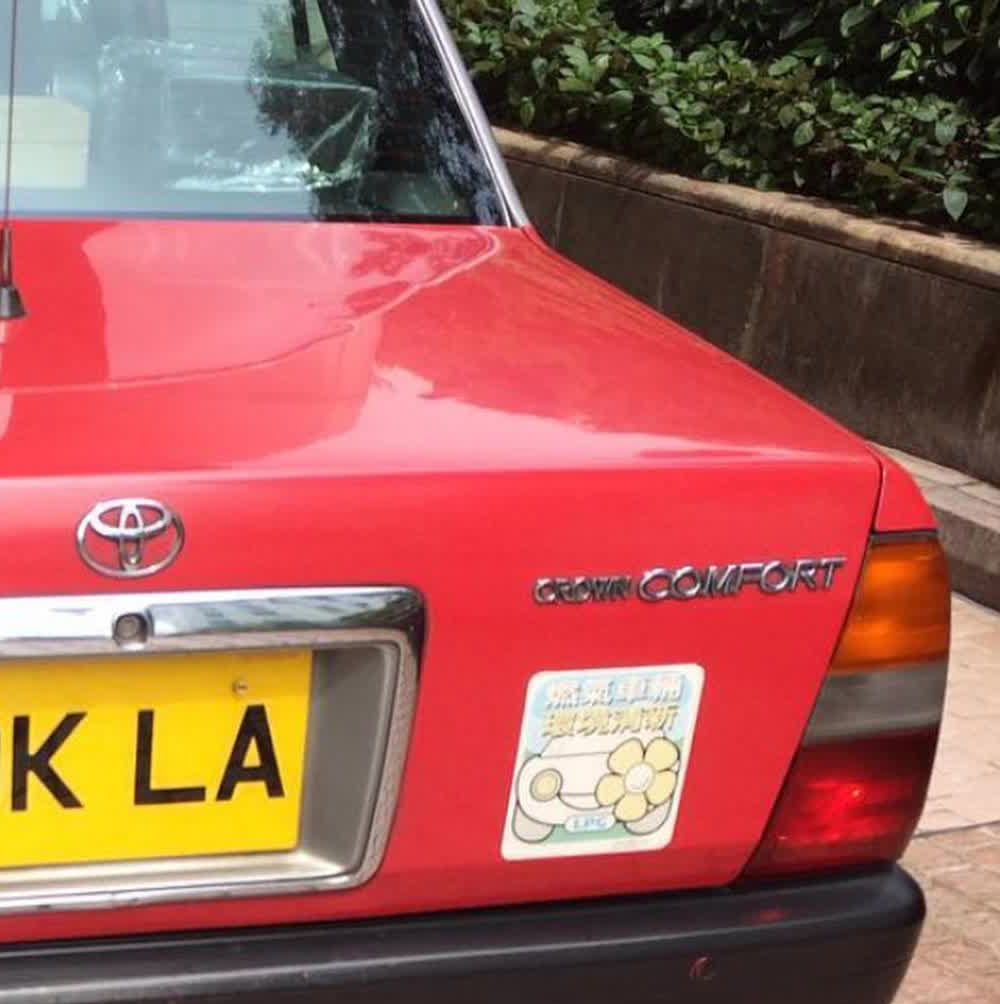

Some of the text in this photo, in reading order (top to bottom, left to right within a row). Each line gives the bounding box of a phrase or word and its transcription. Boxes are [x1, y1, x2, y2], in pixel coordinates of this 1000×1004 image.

[533, 556, 846, 604] CROWN COMFORT
[134, 703, 286, 806] LA
[571, 815, 607, 829] LPG
